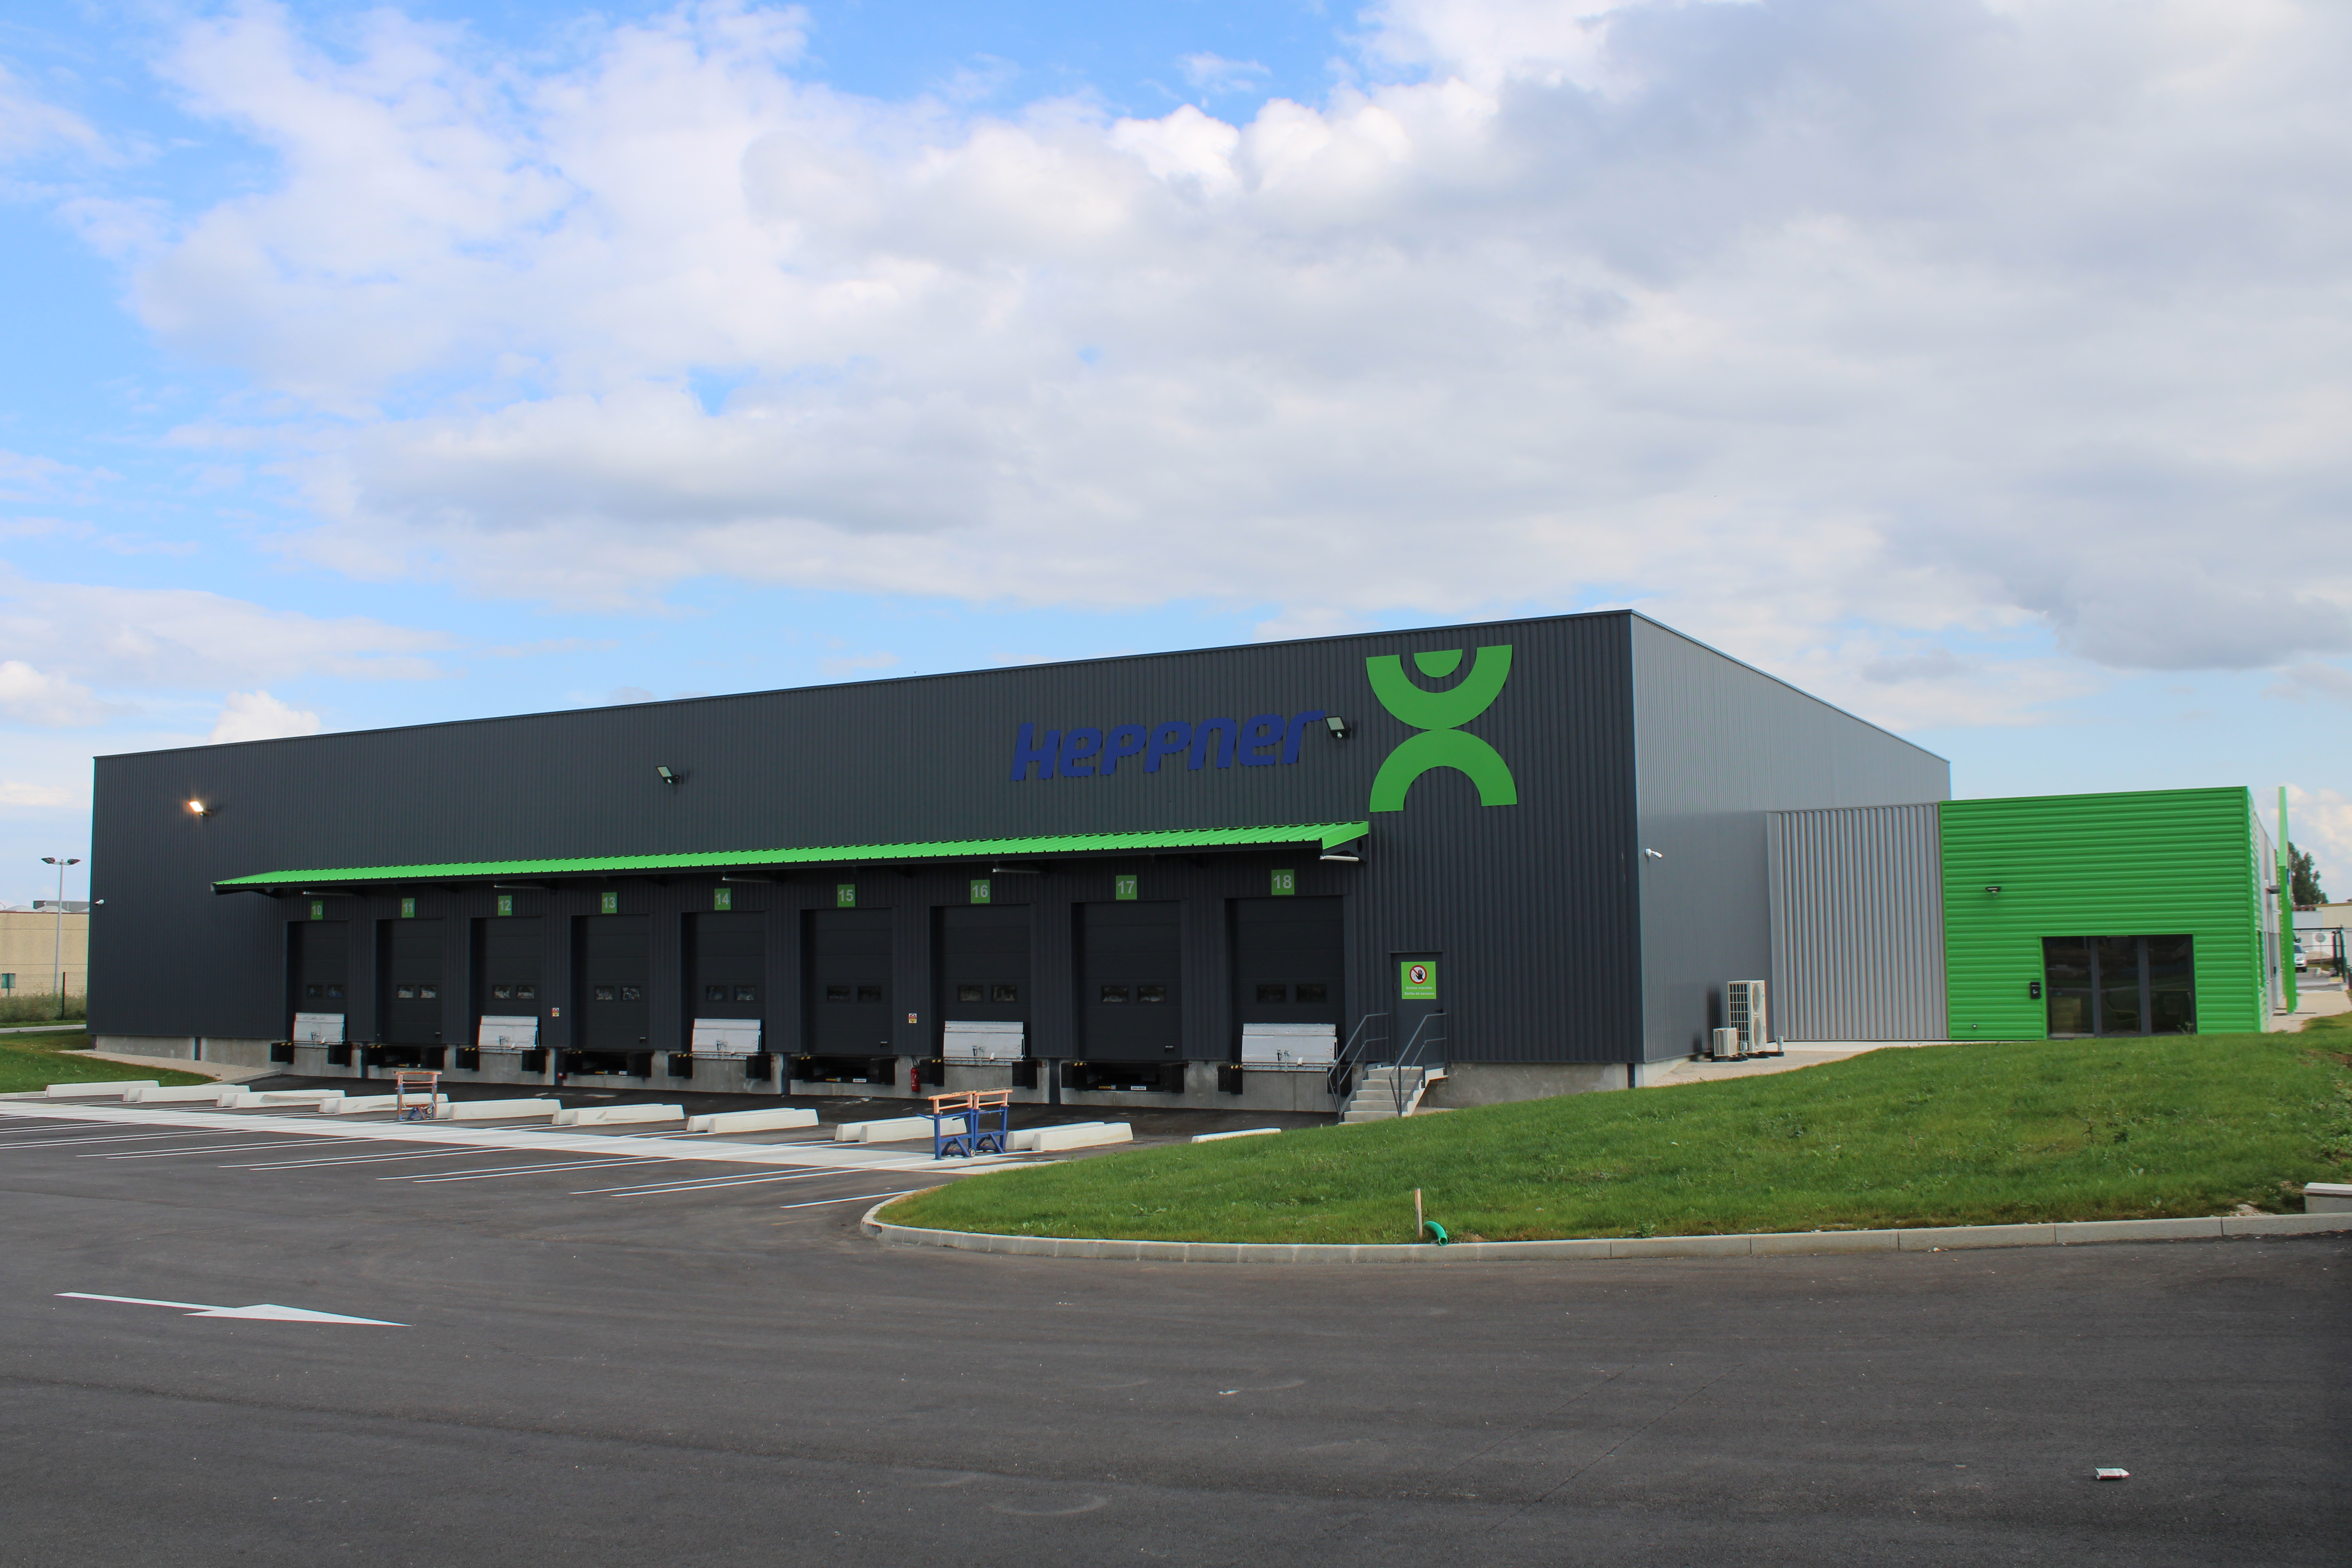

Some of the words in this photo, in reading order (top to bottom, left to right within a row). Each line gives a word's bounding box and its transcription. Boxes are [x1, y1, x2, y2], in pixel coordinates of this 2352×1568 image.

[1118, 880, 1135, 894] 17
[1274, 875, 1292, 889] 18
[839, 889, 854, 902] 15
[972, 885, 988, 898] 16
[603, 897, 616, 909] 13
[716, 893, 730, 905] 14
[312, 905, 322, 915] 10
[404, 902, 414, 913] 11
[499, 900, 511, 911] 12
